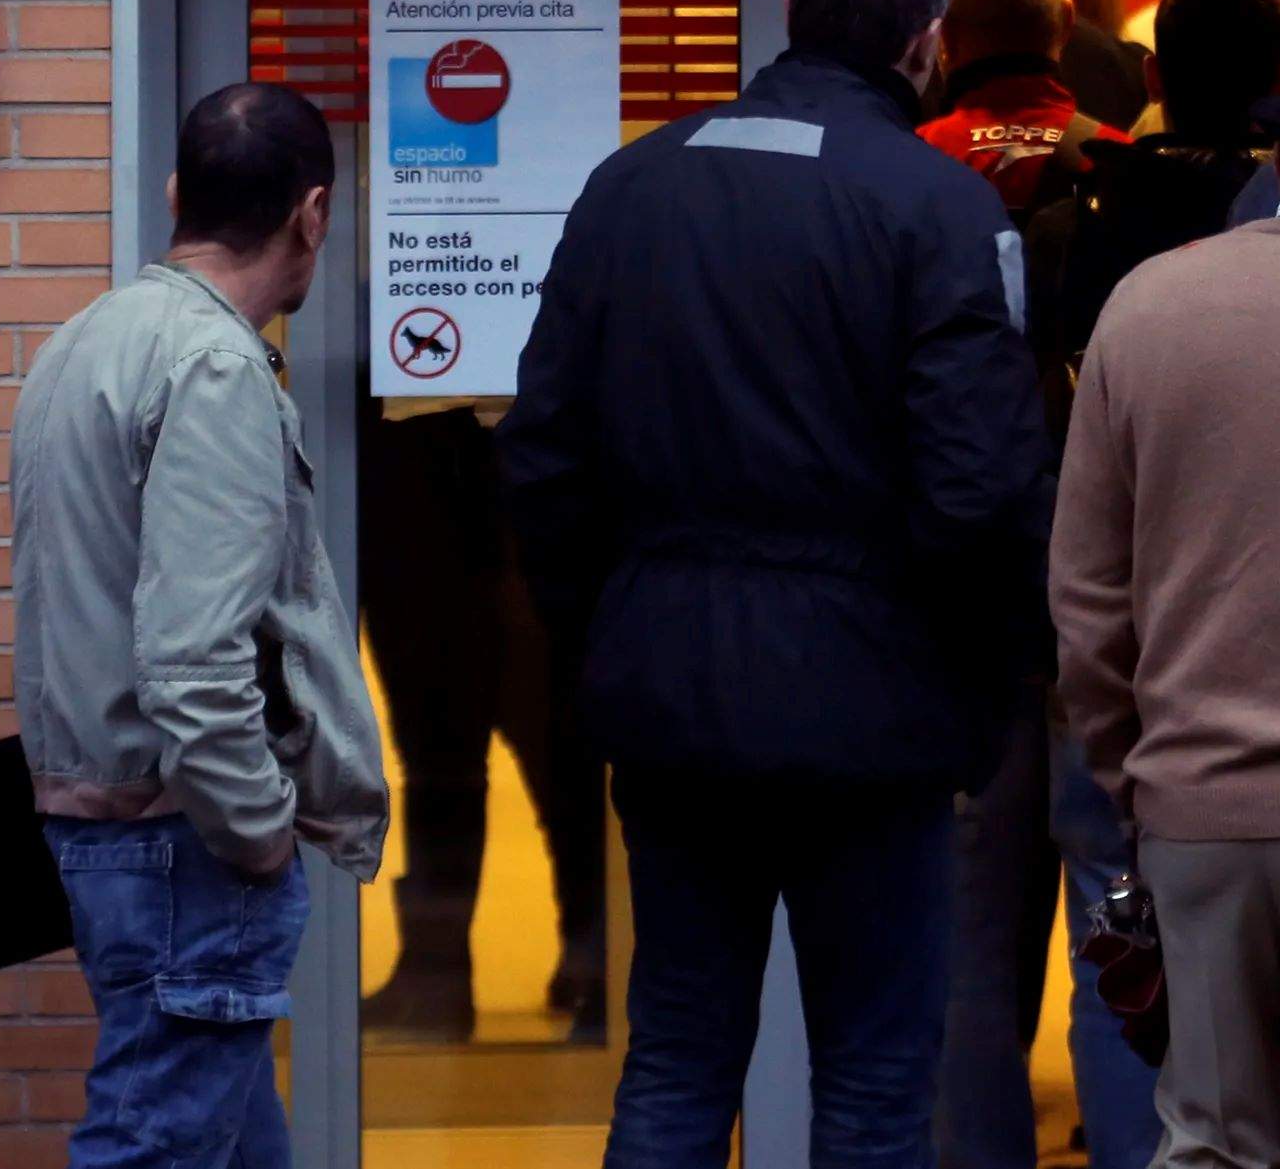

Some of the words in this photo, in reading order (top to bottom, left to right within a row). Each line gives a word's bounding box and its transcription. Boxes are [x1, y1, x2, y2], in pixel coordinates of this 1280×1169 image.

[386, 0, 471, 18] Atención
[476, 0, 535, 22] previa
[539, 0, 574, 18] cita
[970, 125, 1064, 142] TOPPE
[394, 144, 467, 165] espacio
[394, 165, 422, 184] sin
[427, 167, 483, 184] humo
[389, 232, 419, 249] No
[426, 231, 472, 249] está
[389, 254, 493, 276] permitido
[500, 254, 519, 272] el
[389, 282, 467, 297] acceso
[474, 282, 514, 296] con
